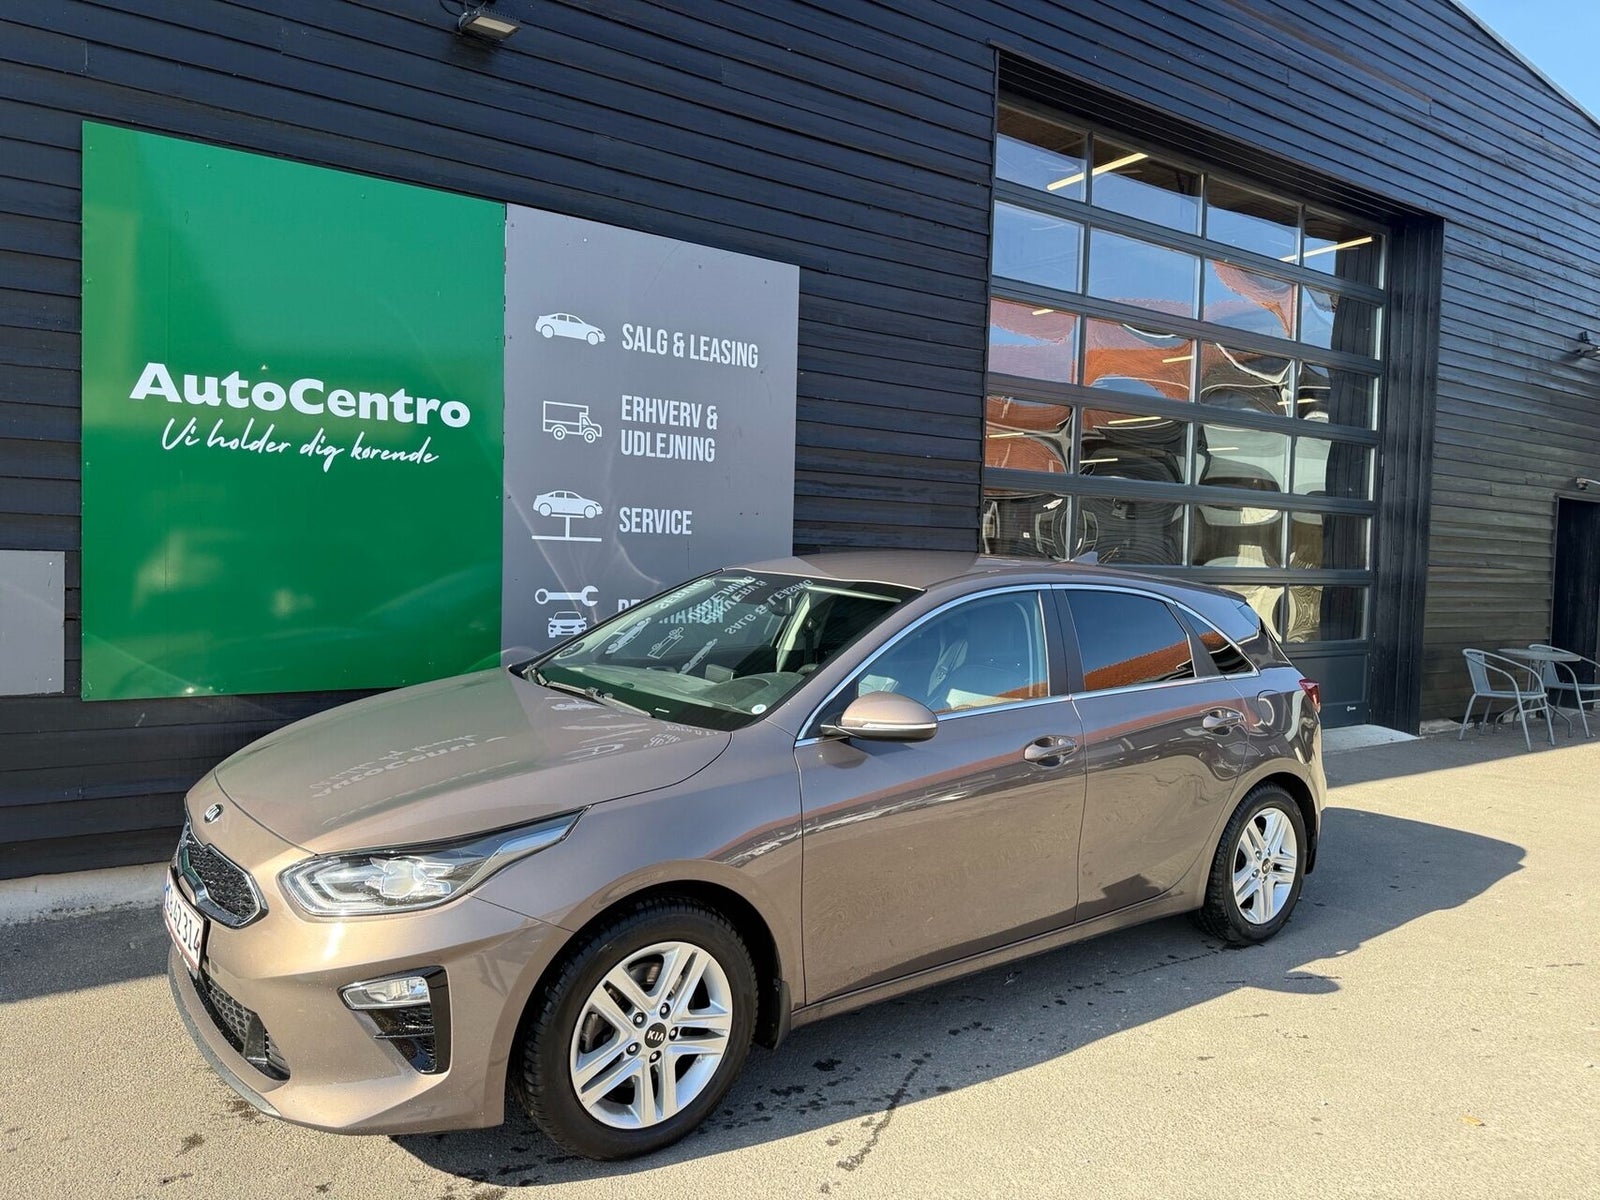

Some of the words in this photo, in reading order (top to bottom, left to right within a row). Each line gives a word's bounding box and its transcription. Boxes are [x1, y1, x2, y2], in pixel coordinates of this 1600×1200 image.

[622, 323, 668, 355] SALG
[672, 331, 685, 358] &
[690, 334, 759, 369] LEASING
[129, 362, 471, 428] AutoCentro
[621, 394, 702, 428] ERHVERV
[706, 405, 718, 430] &
[162, 417, 200, 450] Vi
[207, 417, 291, 454] holder
[299, 427, 345, 473] dig
[621, 429, 716, 462] UDLEJNING
[619, 507, 693, 535] SERVICE
[647, 1030, 665, 1042] KIA
